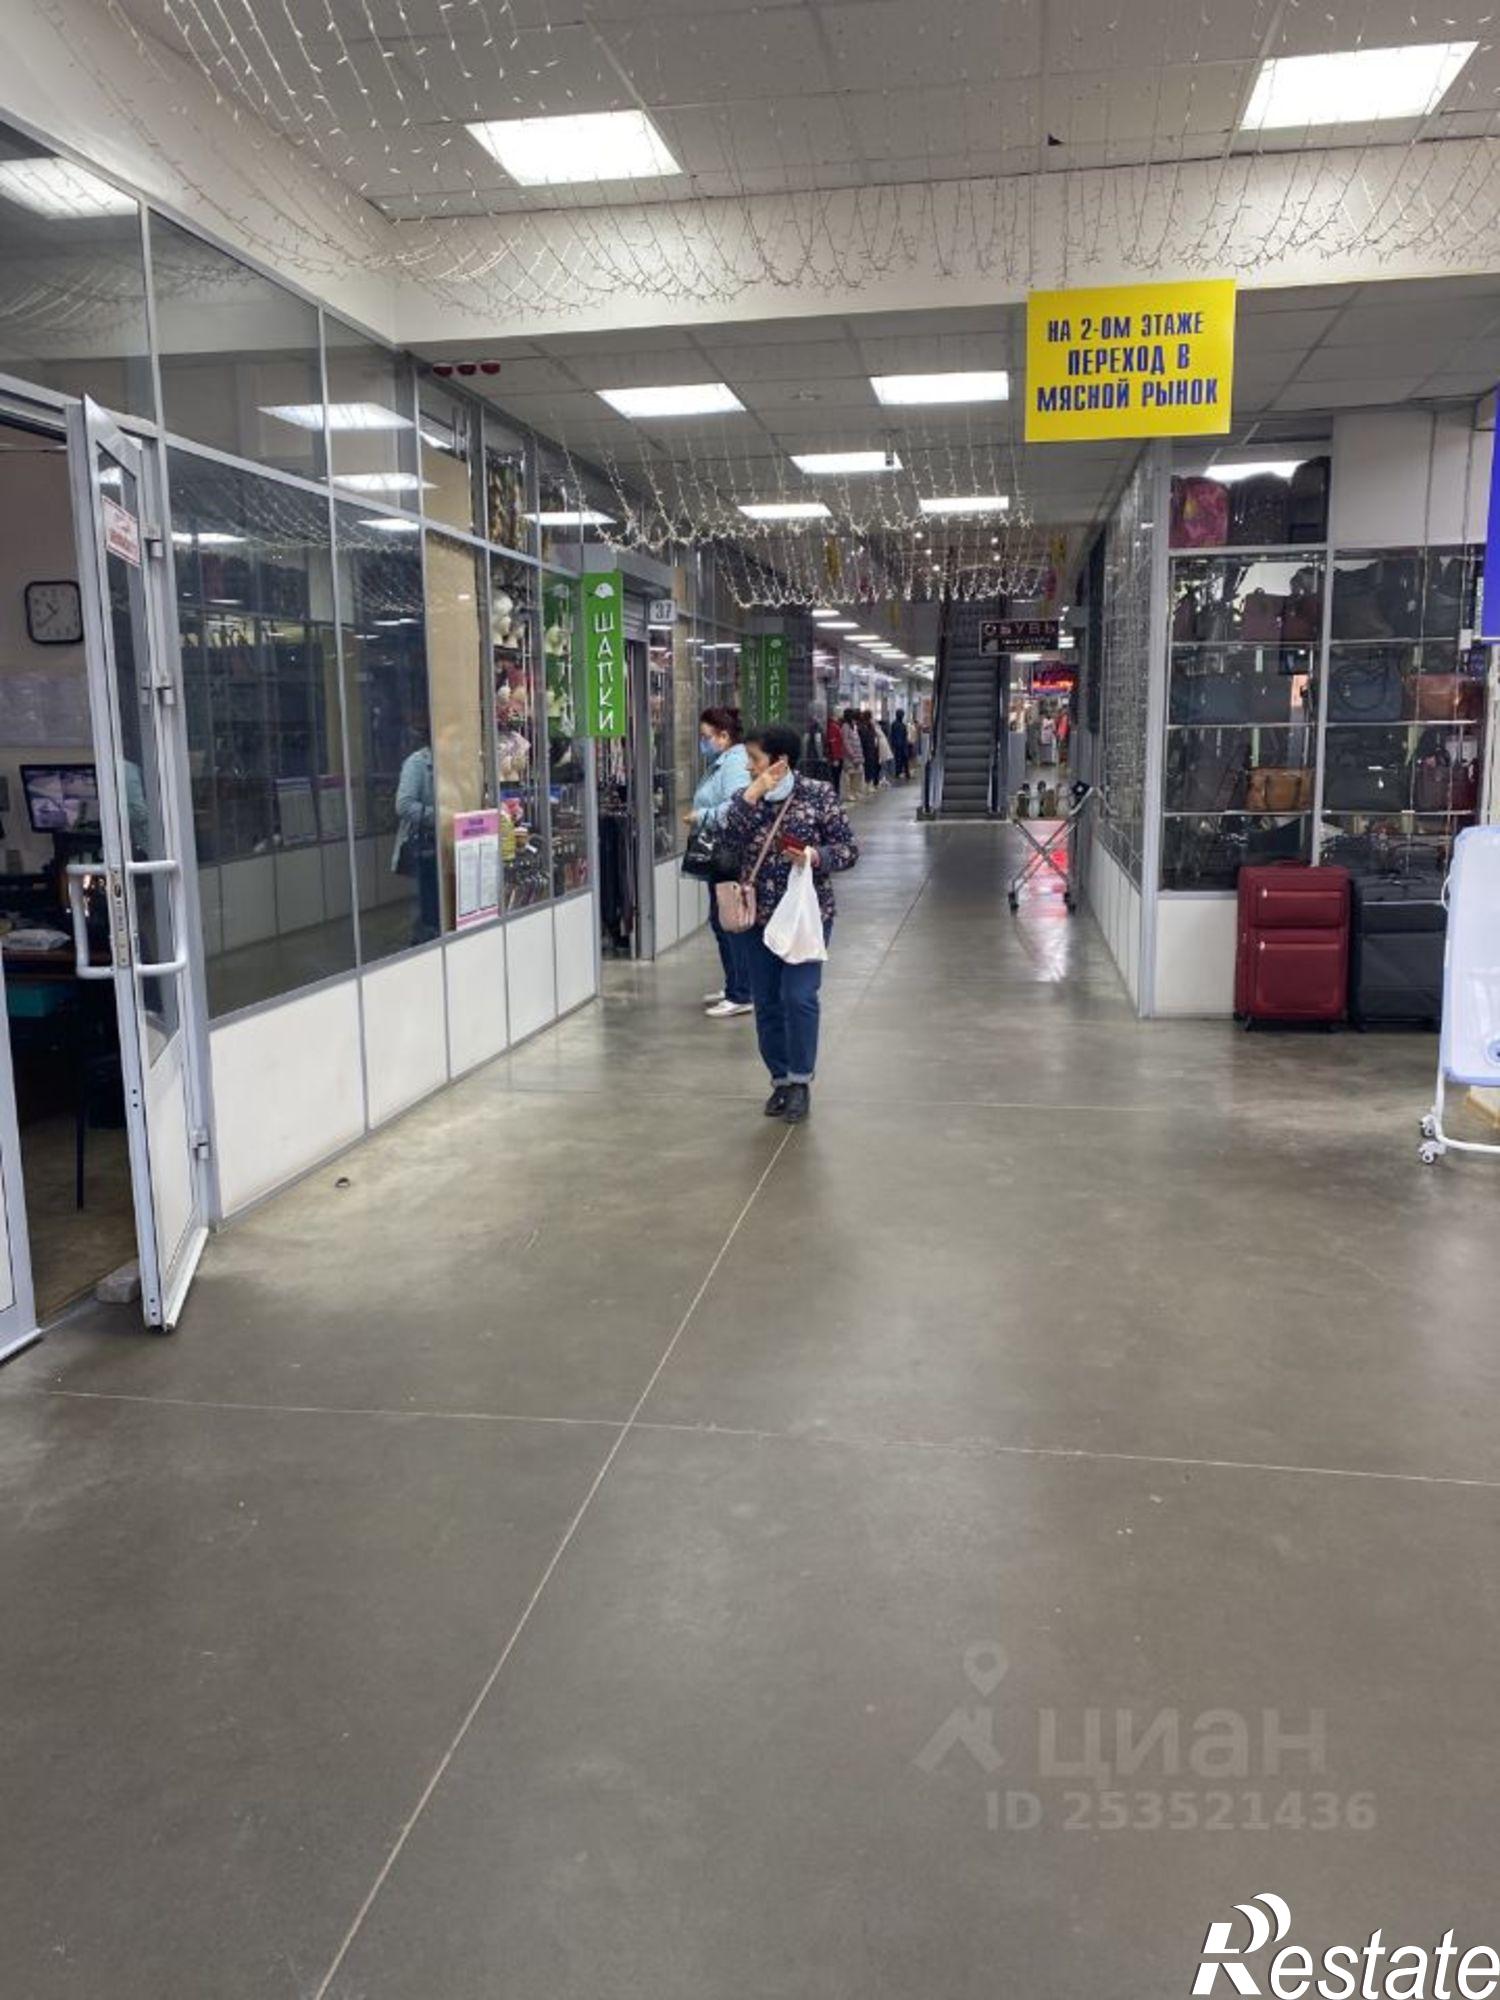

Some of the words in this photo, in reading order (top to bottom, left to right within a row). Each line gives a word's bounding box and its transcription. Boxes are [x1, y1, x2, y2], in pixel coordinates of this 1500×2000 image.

[1047, 319, 1071, 342] НА
[1080, 316, 1131, 341] 2-ОМ
[1141, 311, 1204, 337] ЭТАЖЕ
[1067, 345, 1166, 376] ПЕРЕХОД
[1177, 343, 1191, 369] В
[1036, 378, 1130, 412] МЯСНОЙ
[1142, 378, 1218, 407] РЫНОК
[655, 602, 672, 619] 37
[594, 611, 615, 731] ШАПКИ
